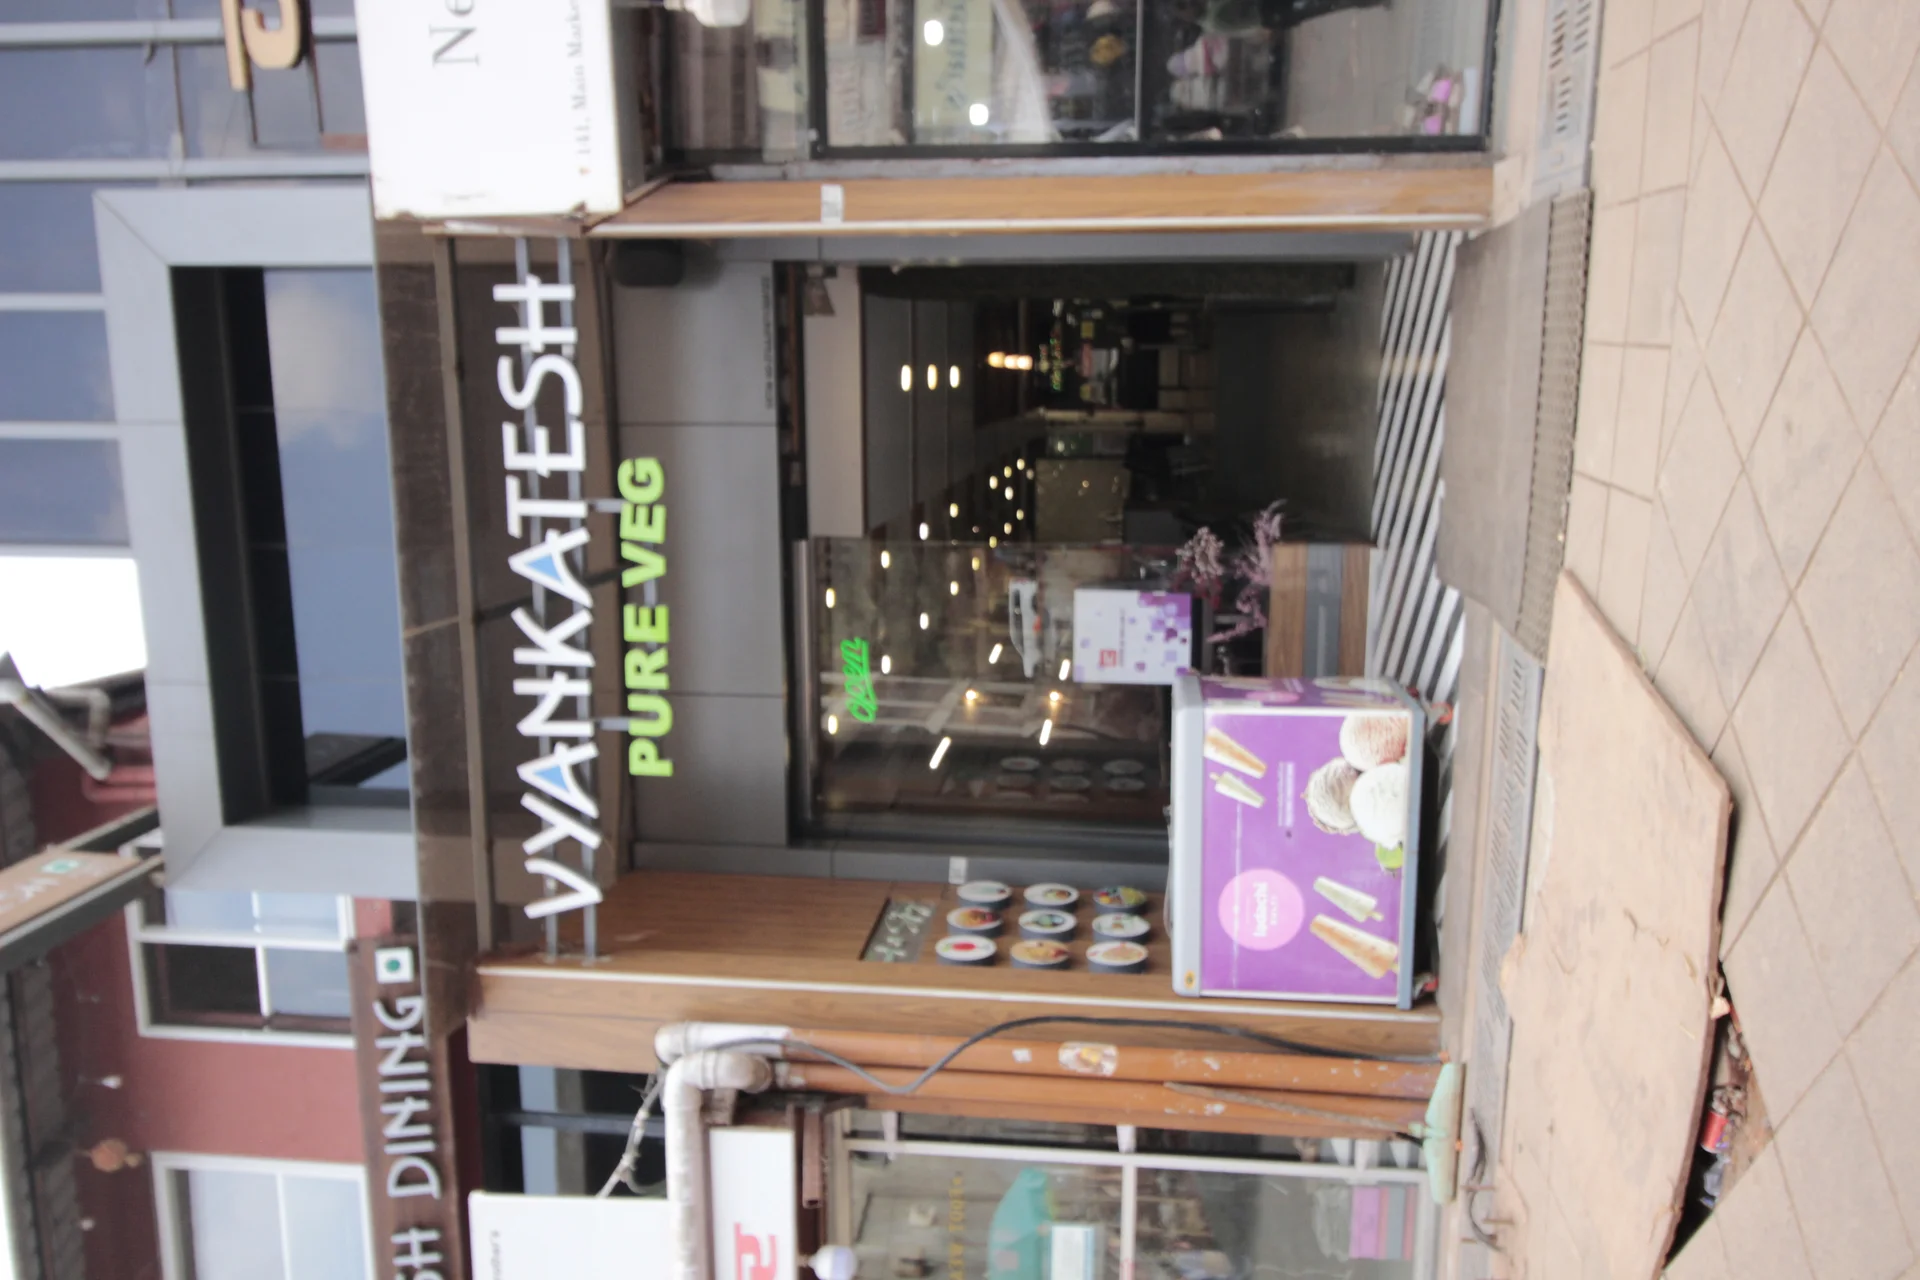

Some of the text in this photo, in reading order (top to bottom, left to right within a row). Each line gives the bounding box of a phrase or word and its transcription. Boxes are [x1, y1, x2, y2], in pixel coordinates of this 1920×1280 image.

[570, 65, 587, 110] Main
[492, 274, 603, 919] VYANKATESH
[617, 457, 673, 777] PURE VEG
[372, 995, 442, 1200] DINING
